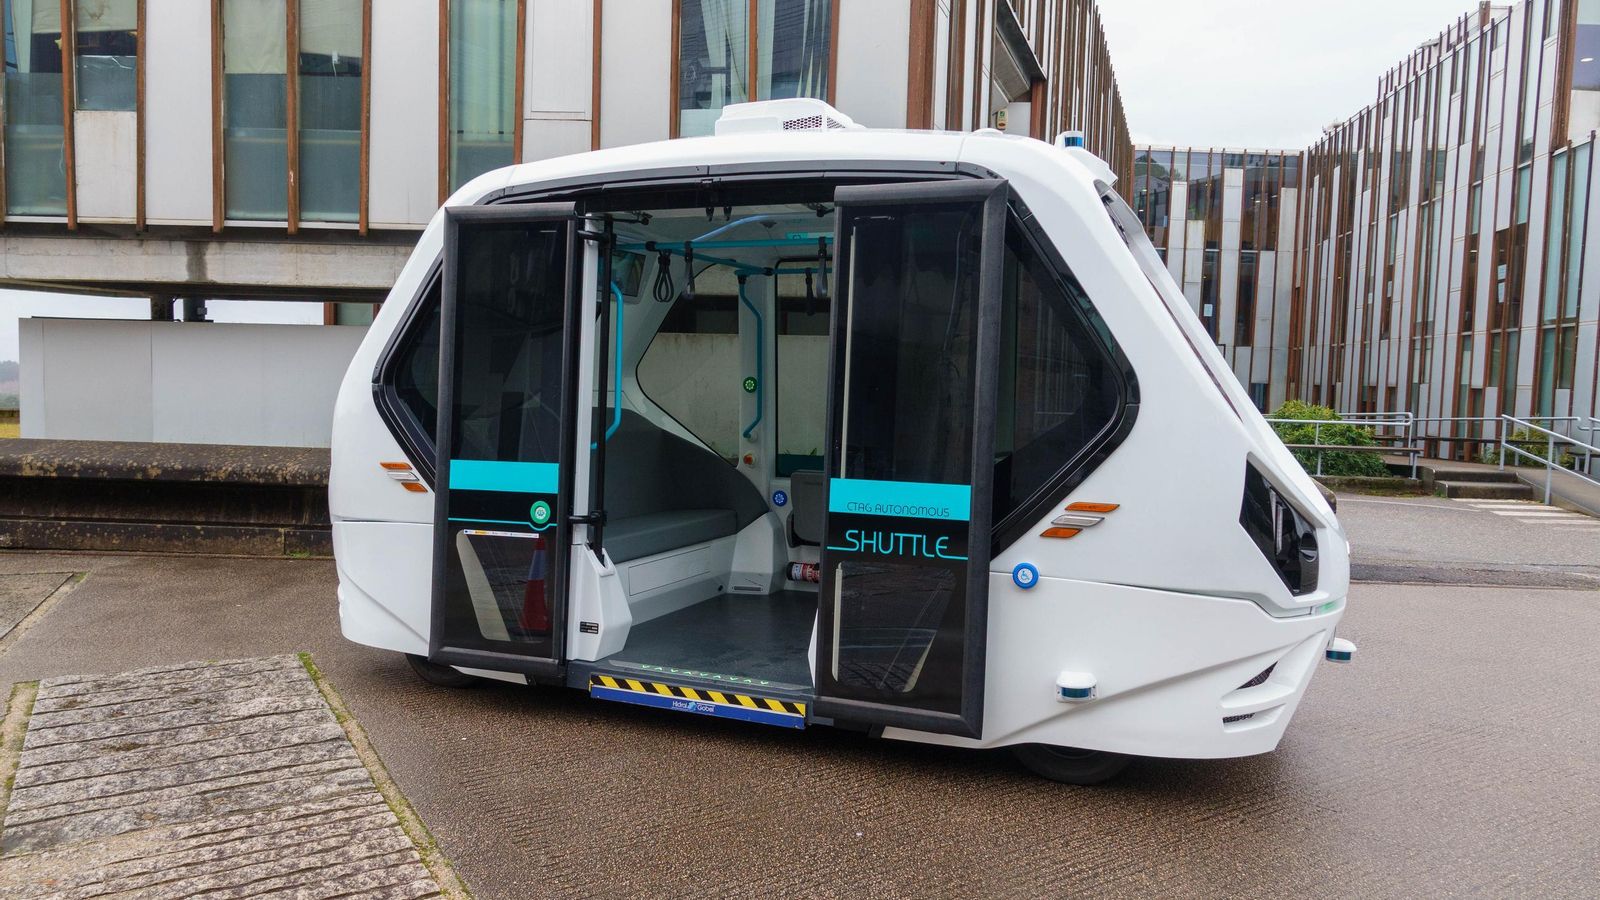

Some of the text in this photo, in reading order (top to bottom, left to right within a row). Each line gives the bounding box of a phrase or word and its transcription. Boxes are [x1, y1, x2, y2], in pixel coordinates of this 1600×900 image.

[846, 501, 951, 518] CTAG AUTONOMOUS
[845, 529, 951, 559] SHUTTLE
